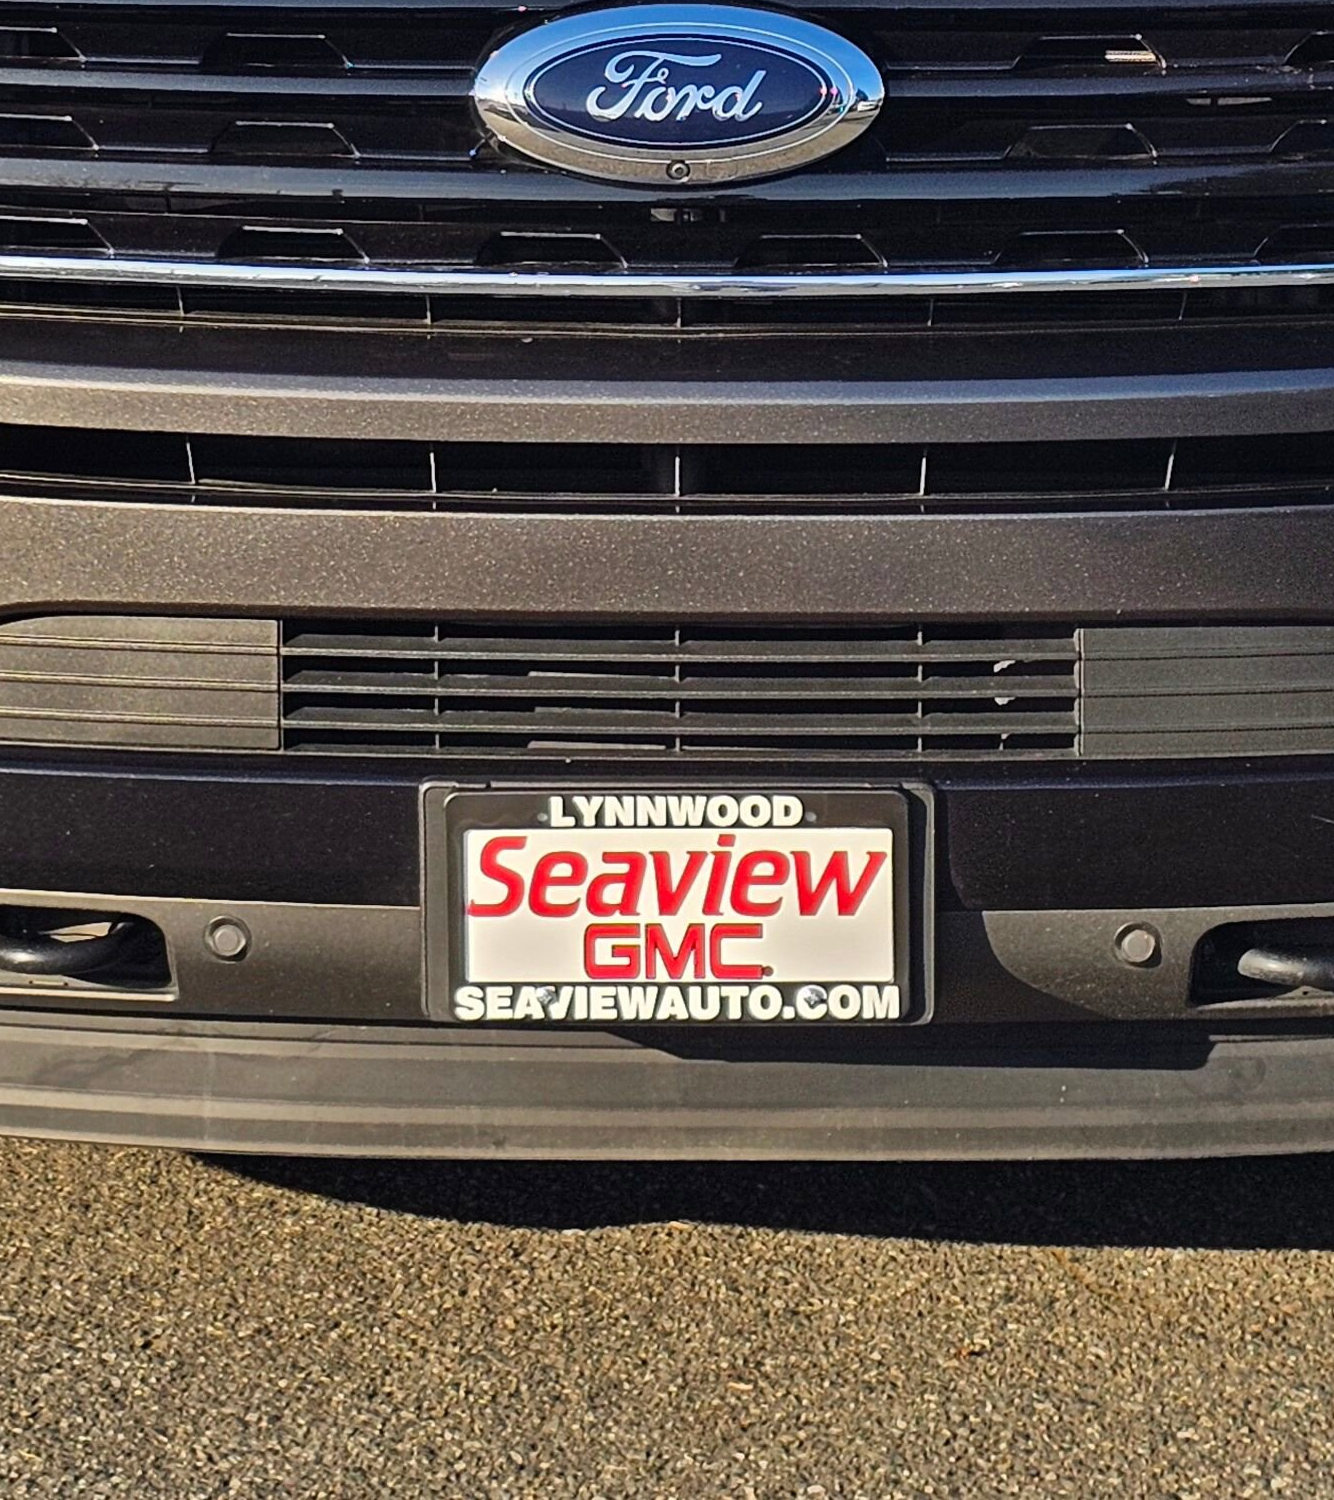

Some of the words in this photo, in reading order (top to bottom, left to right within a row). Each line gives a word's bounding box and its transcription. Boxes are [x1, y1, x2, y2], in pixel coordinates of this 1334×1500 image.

[586, 50, 767, 122] Ford
[549, 795, 804, 828] LYNNWOOD
[468, 834, 888, 917] Seaview
[584, 923, 767, 980] GMC
[455, 985, 900, 1021] SEAVIEWAUTO.COM
